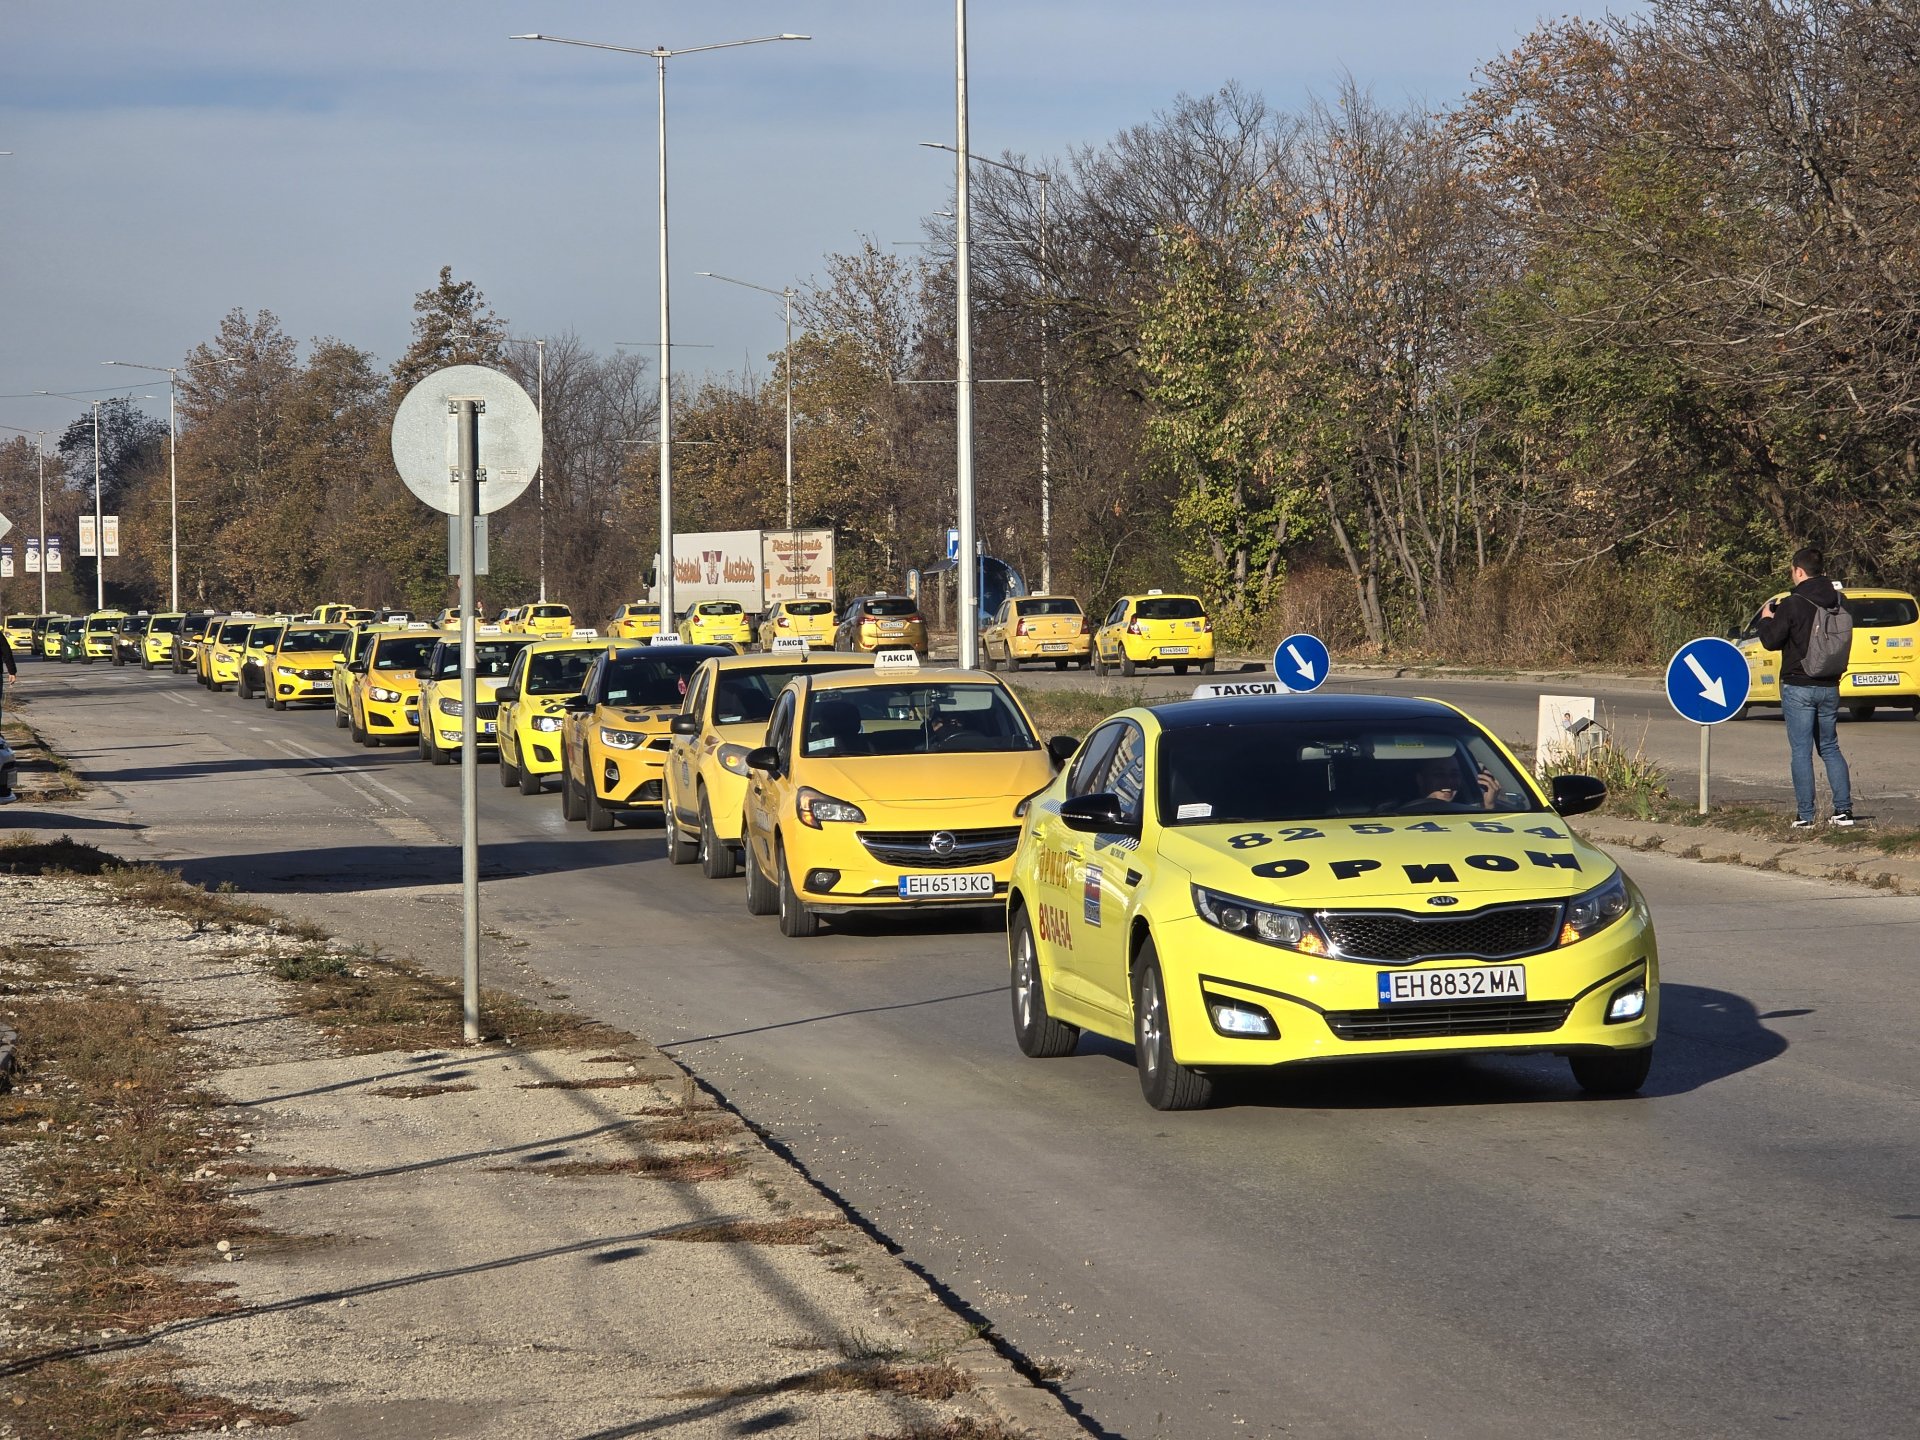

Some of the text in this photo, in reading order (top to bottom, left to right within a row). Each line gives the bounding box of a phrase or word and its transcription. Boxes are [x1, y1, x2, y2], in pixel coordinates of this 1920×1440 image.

[723, 555, 755, 584] Austria
[776, 574, 821, 586] Austria
[777, 639, 804, 647] ТАКСИ
[881, 654, 913, 662] ТАКСИ
[1209, 683, 1277, 696] ТАКСИ
[1251, 850, 1583, 884] ОРИОН
[1431, 896, 1456, 905] KIA
[1380, 991, 1391, 999] BG
